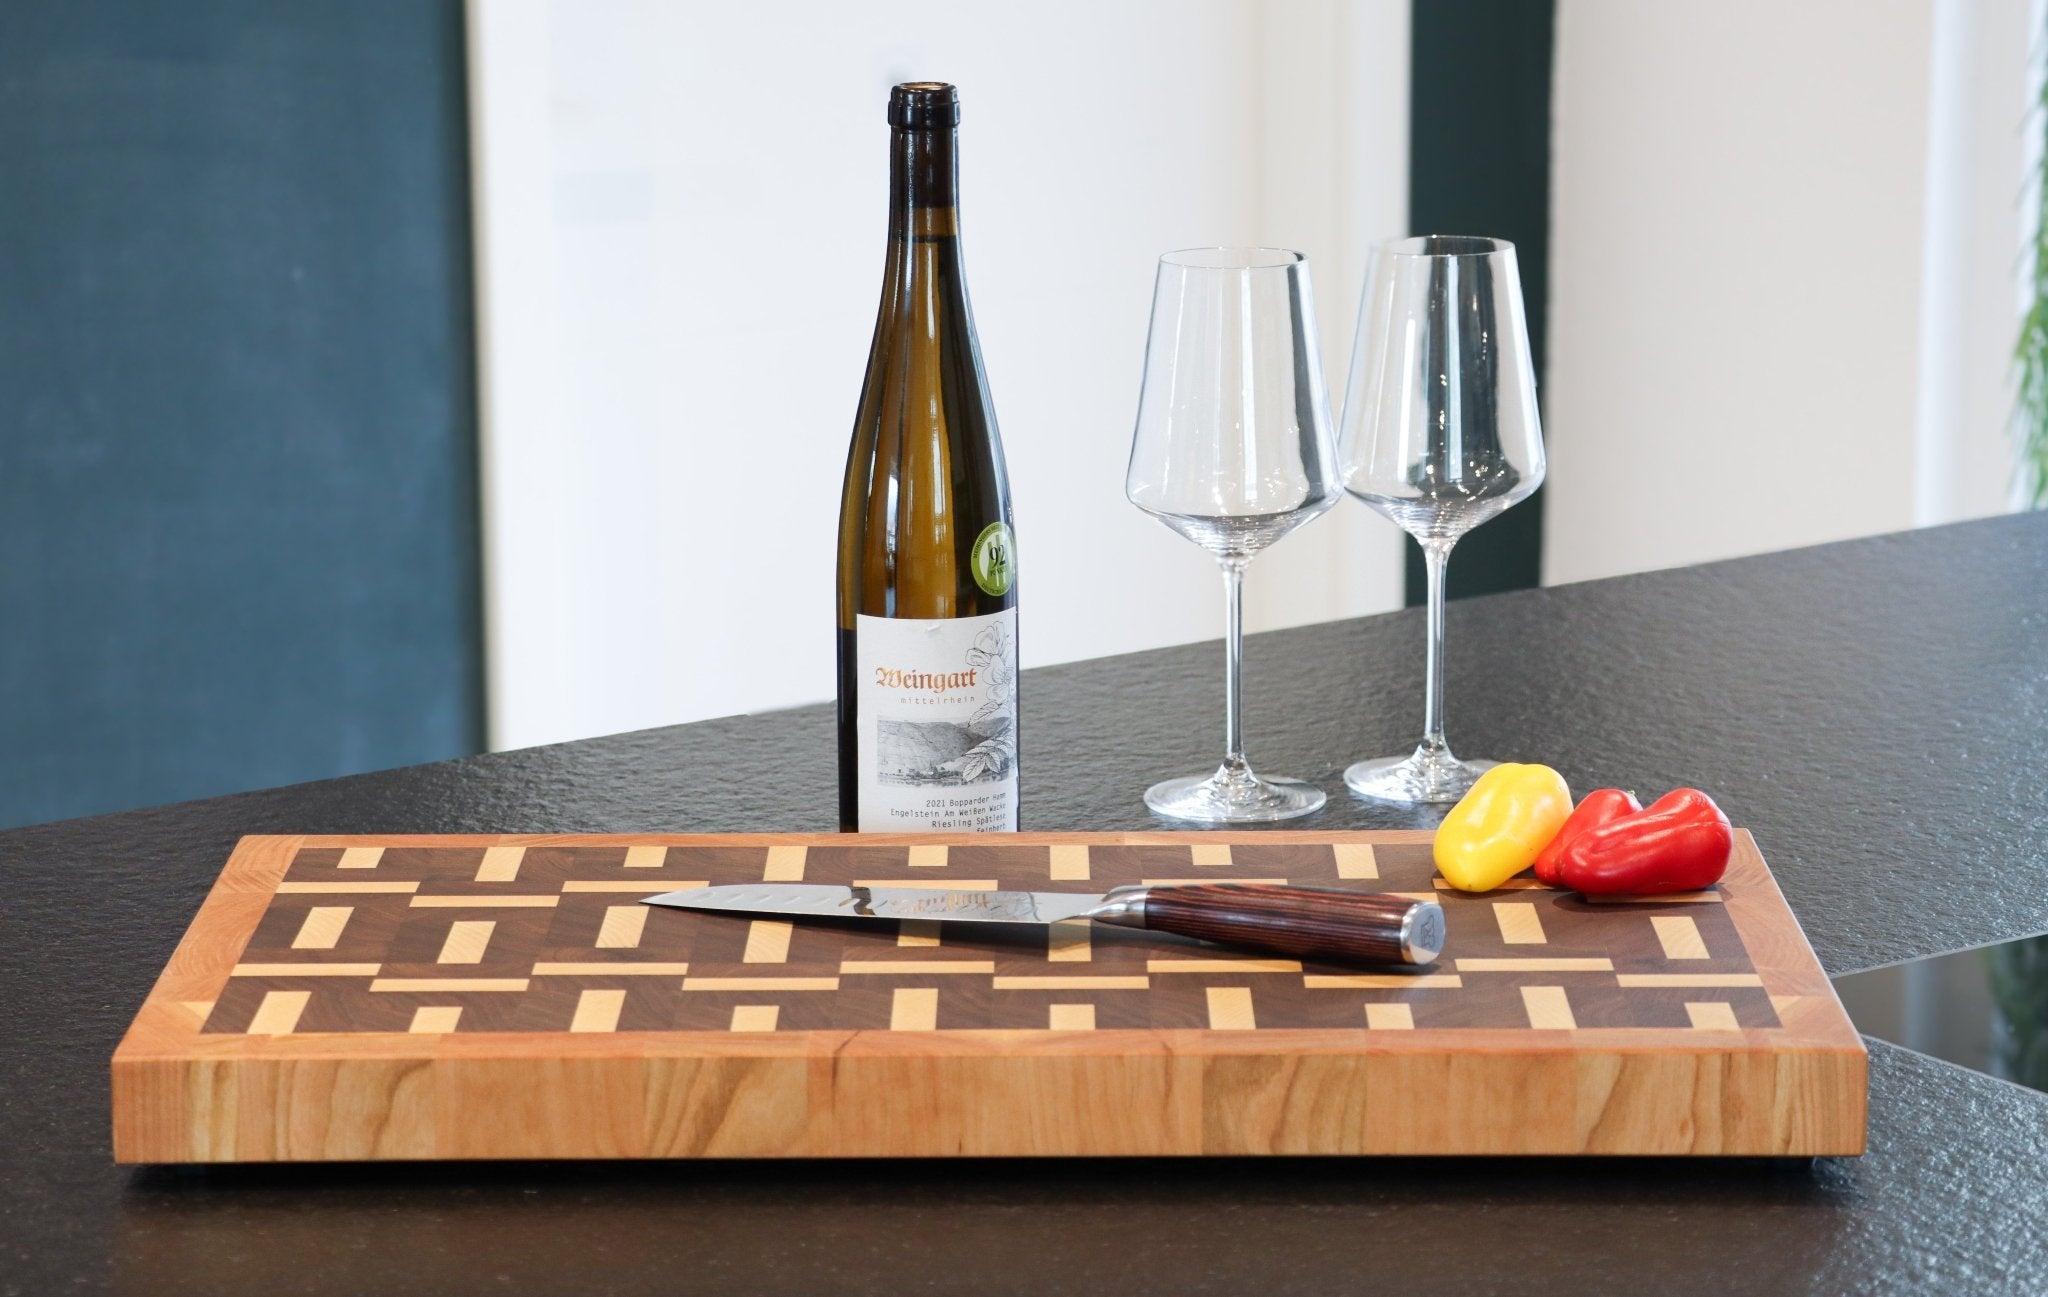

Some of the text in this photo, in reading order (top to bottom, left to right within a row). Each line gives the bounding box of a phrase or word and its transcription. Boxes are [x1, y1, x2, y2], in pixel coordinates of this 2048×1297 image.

[876, 667, 977, 694] Weingart
[901, 696, 975, 705] mittelrhein
[926, 799, 945, 807] 2021
[949, 796, 990, 807] Bopparder
[890, 808, 940, 818] Engelstein
[931, 819, 972, 828] Riesling
